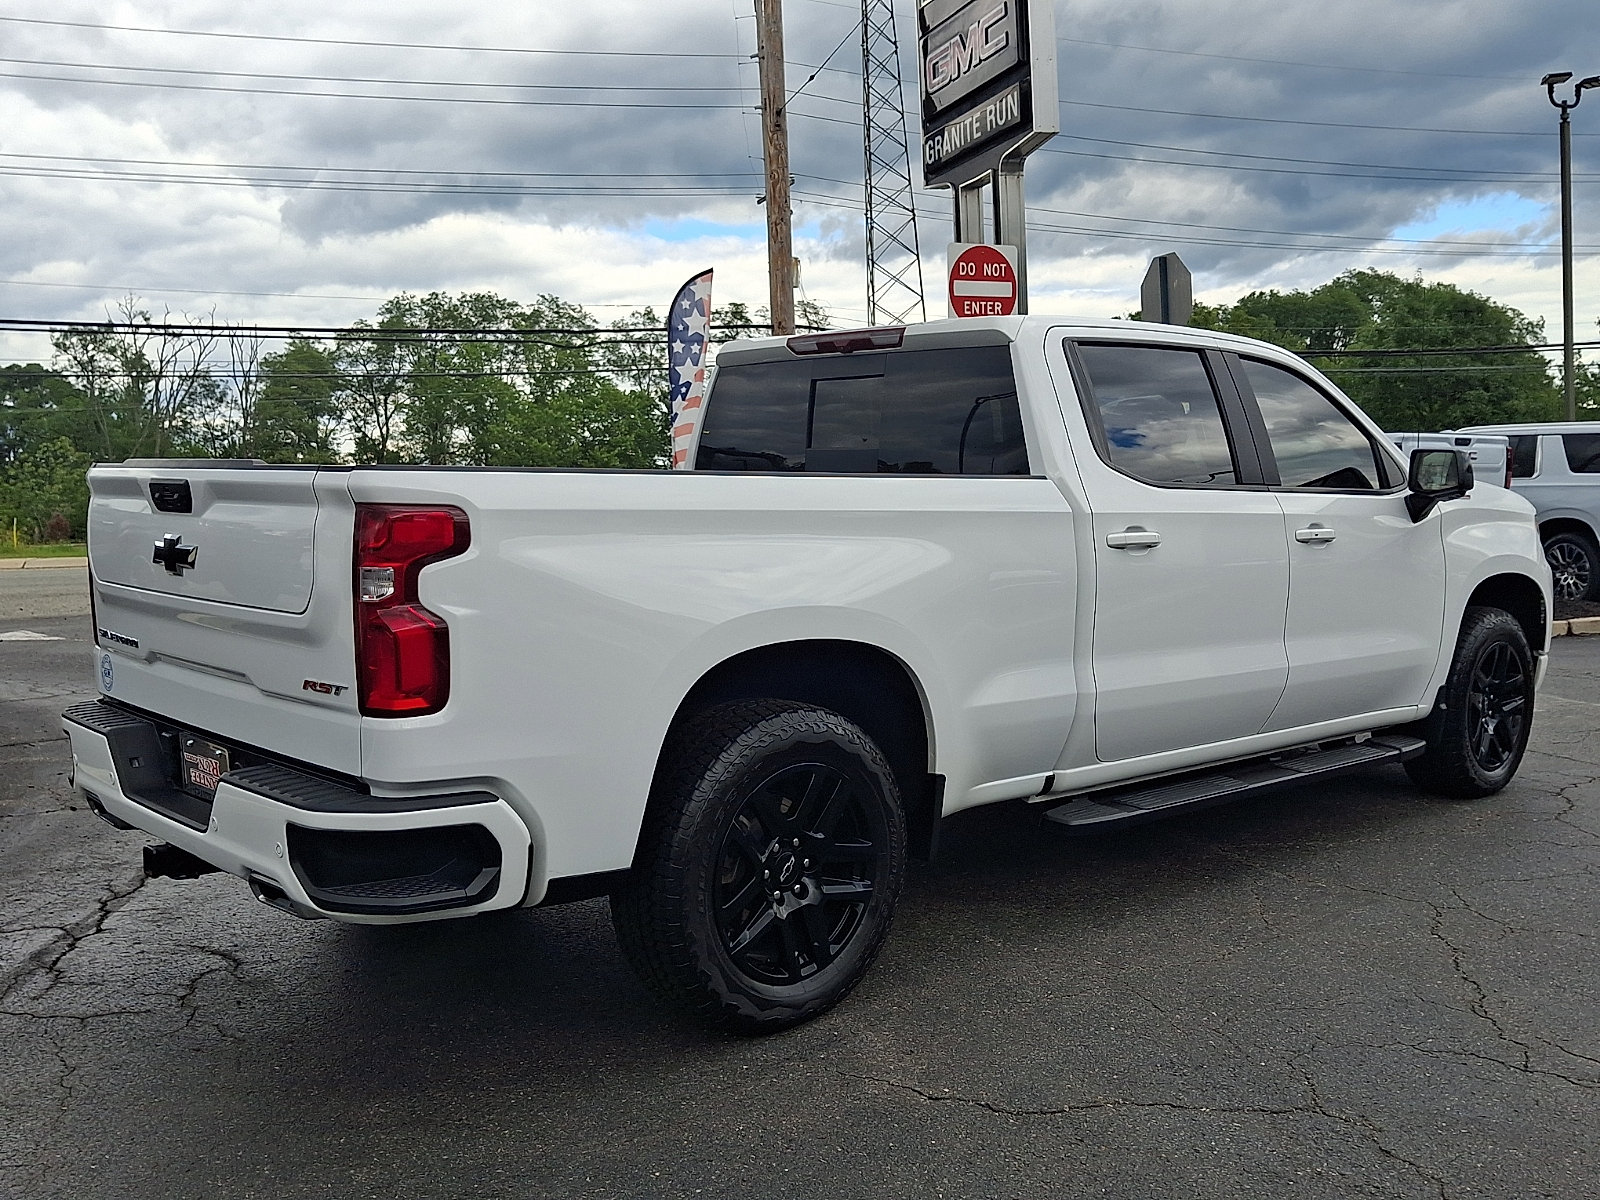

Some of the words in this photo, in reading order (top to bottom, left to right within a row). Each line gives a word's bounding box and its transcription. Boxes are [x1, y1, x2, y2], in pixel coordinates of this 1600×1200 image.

[926, 2, 1009, 93] GMC
[926, 112, 981, 165] GRANITE
[986, 91, 1018, 131] RUN
[959, 262, 976, 276] DO
[983, 263, 1006, 277] NOT
[964, 301, 1002, 315] ENTER
[302, 679, 349, 696] RST
